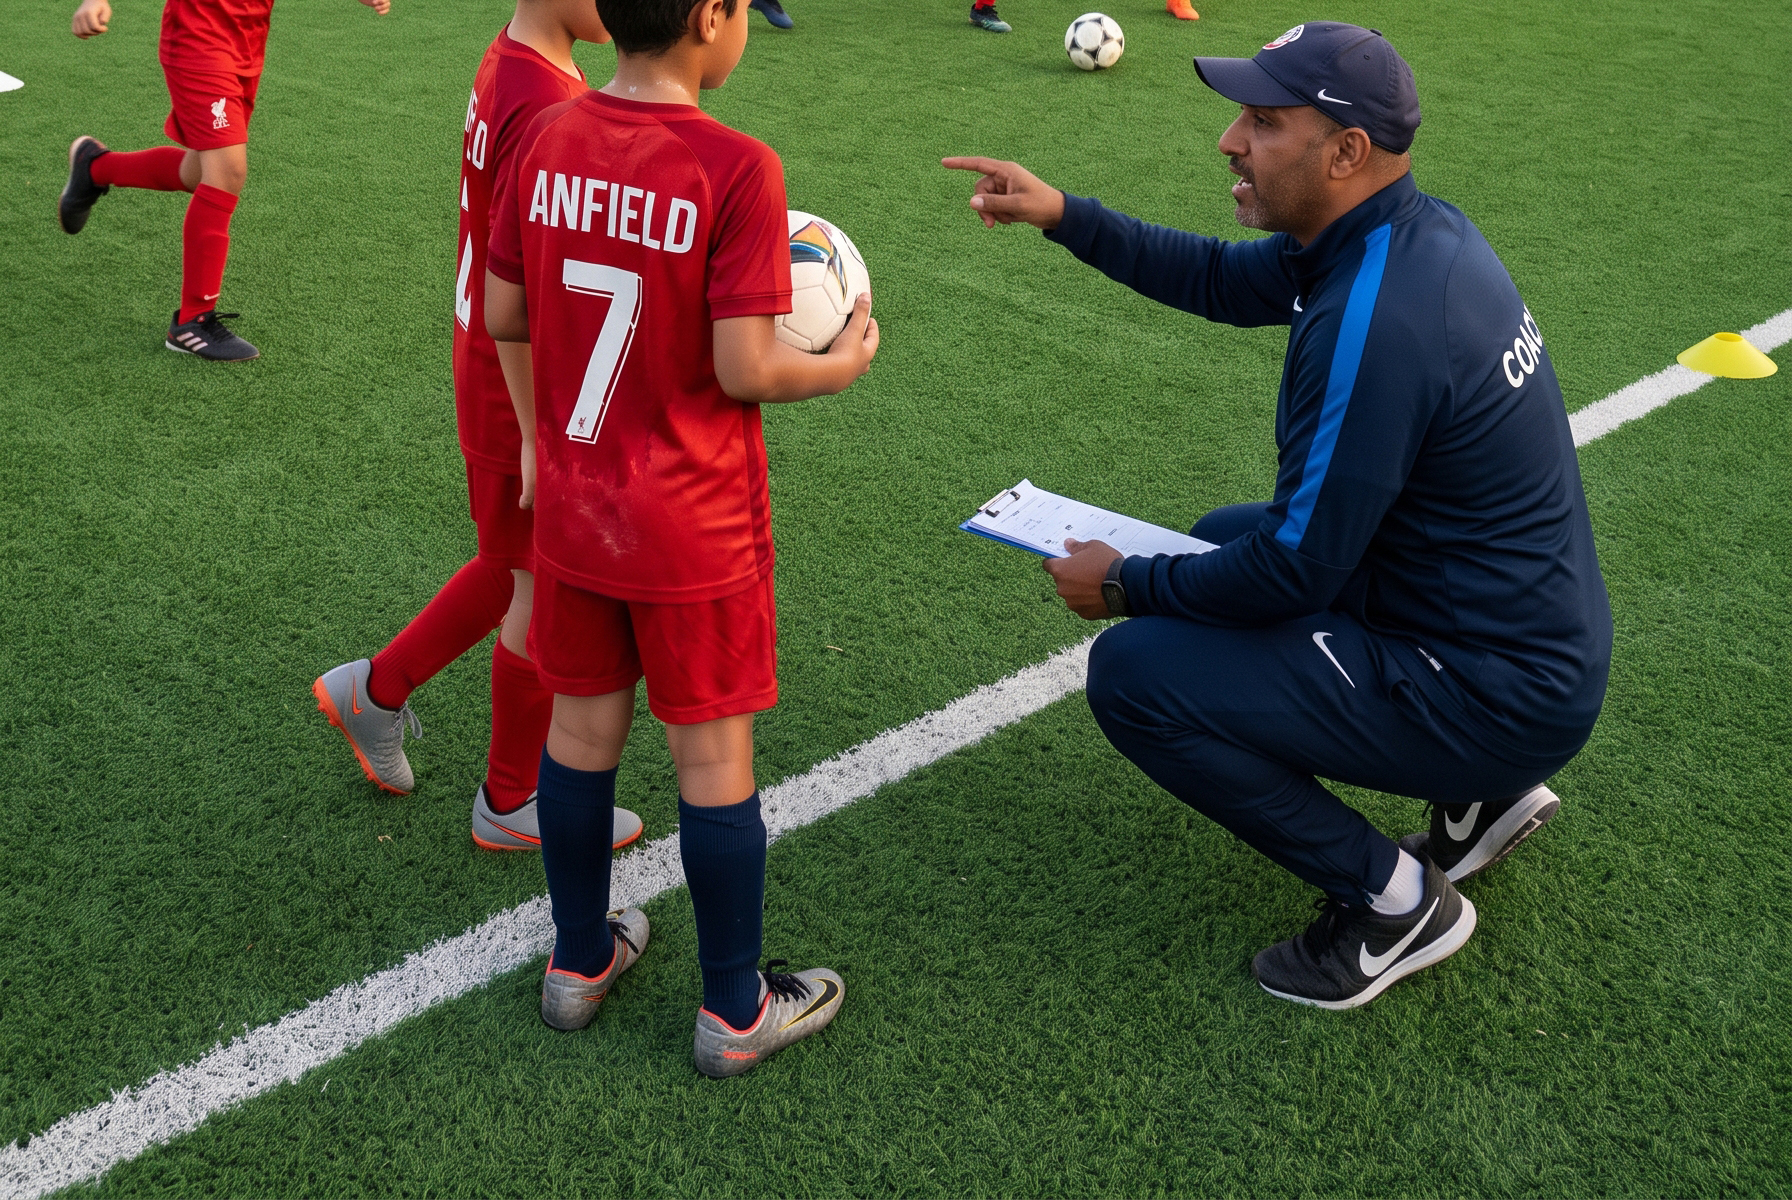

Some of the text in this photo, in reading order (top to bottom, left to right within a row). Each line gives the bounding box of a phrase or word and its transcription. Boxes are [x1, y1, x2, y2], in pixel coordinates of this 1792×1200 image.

[528, 169, 698, 254] ANFIELD
[562, 258, 643, 444] 7
[1503, 303, 1544, 388] COAC
